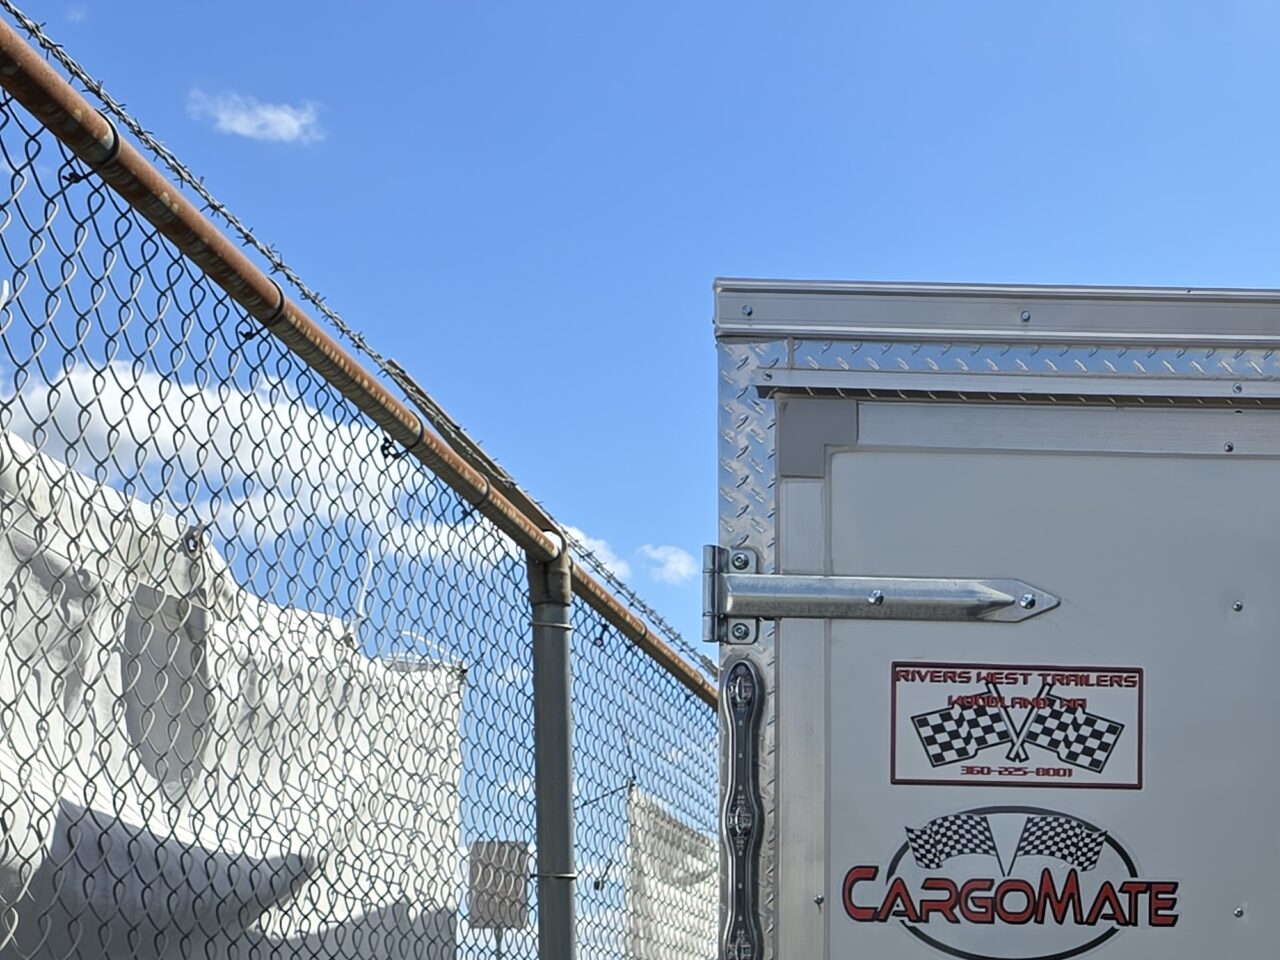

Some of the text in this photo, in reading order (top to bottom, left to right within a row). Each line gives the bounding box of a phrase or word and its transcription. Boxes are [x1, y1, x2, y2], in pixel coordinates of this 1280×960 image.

[895, 669, 1138, 687] RIVERS WEST TRAILERS
[1060, 698, 1087, 709] WA
[960, 766, 1073, 778] 360-225-8001
